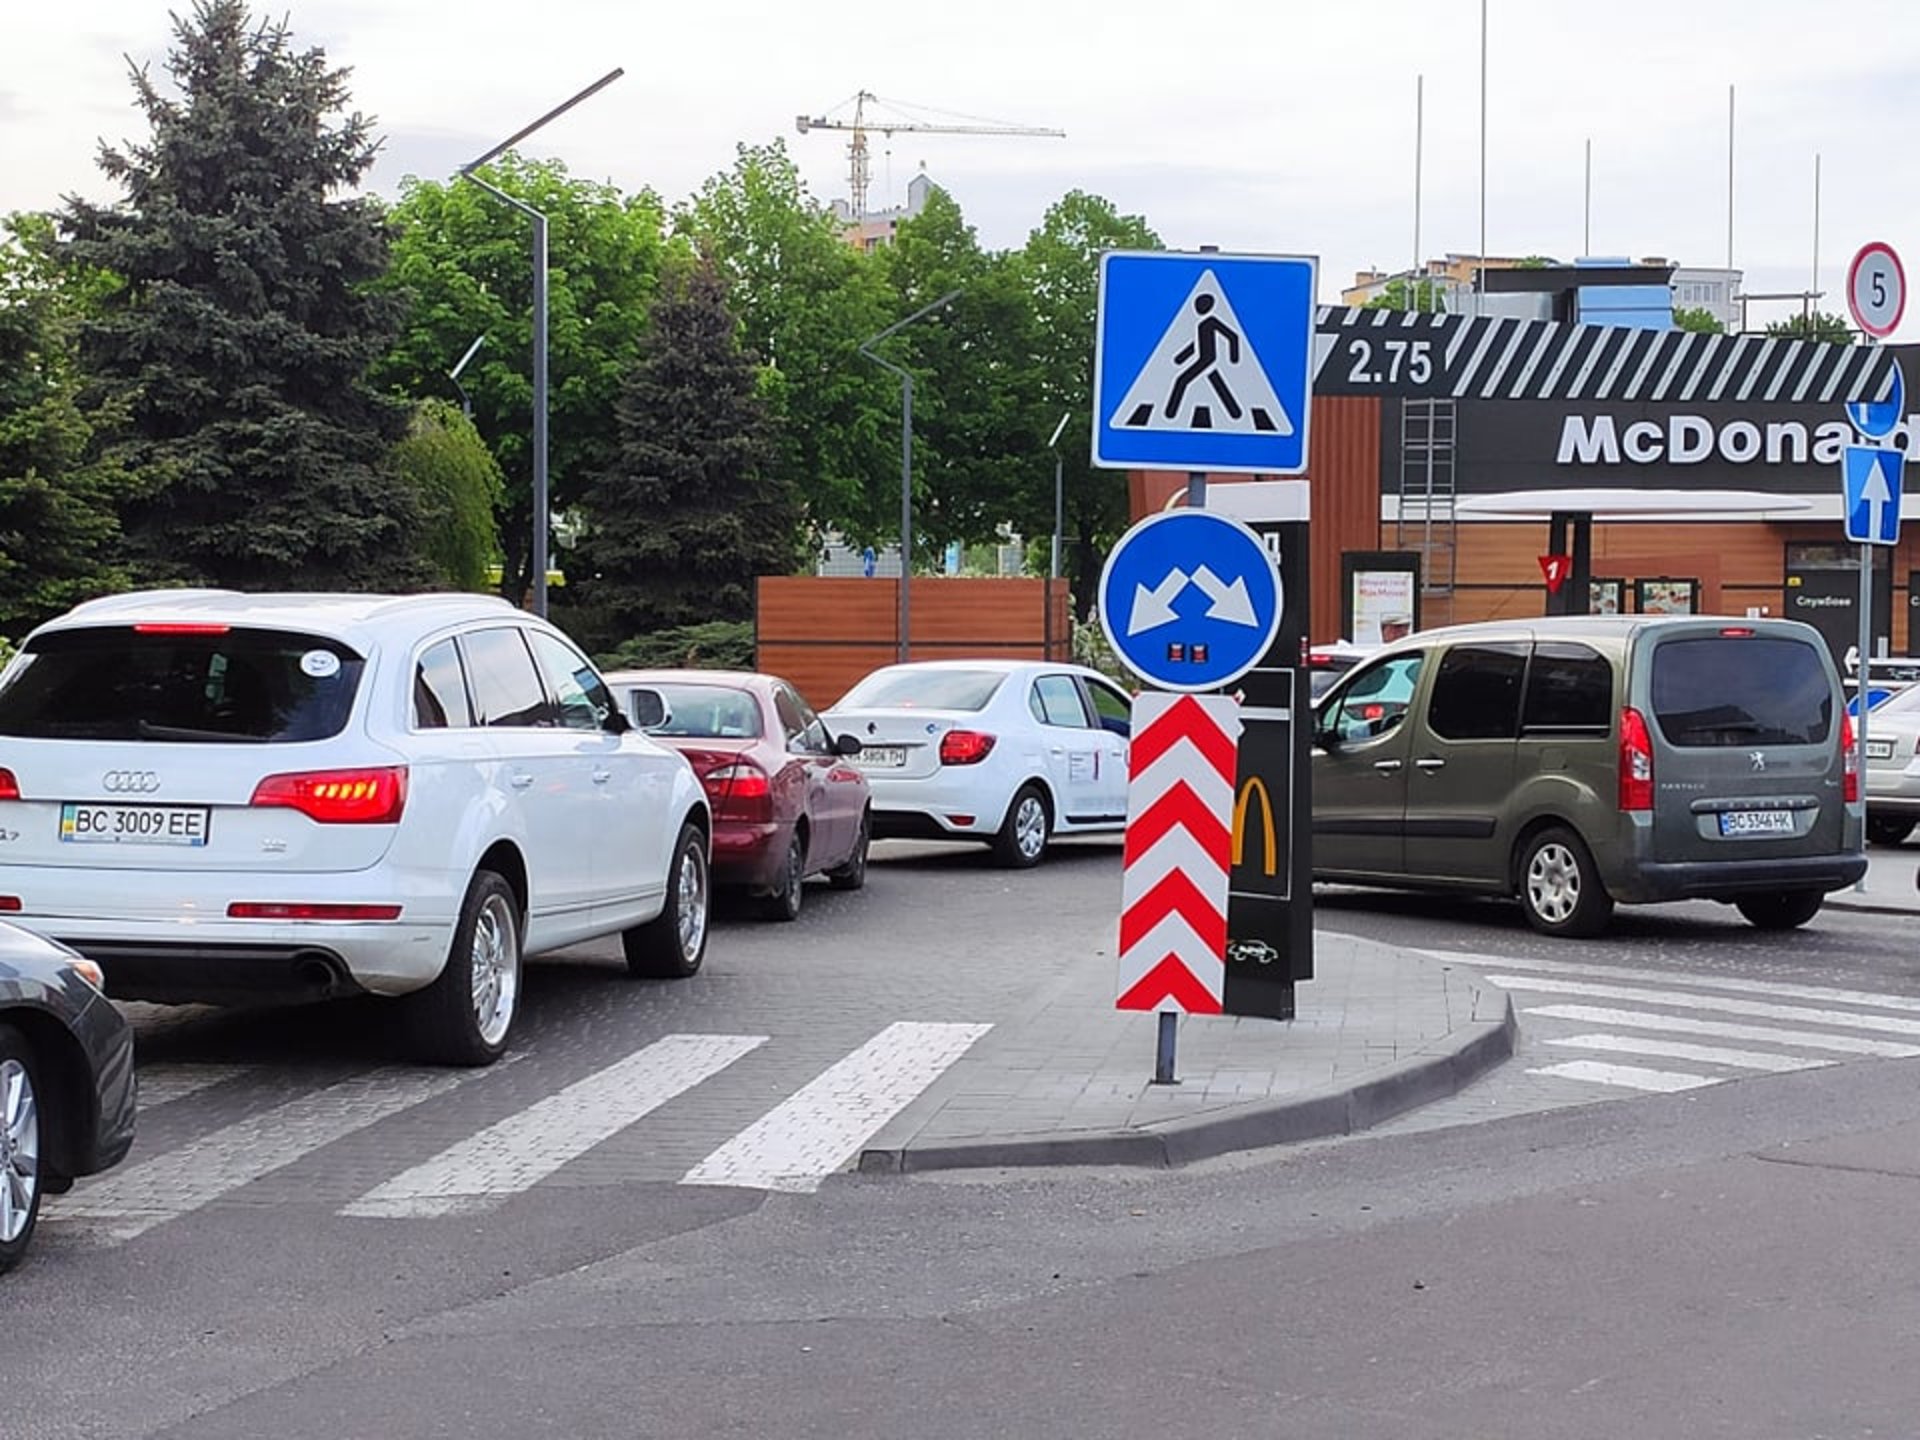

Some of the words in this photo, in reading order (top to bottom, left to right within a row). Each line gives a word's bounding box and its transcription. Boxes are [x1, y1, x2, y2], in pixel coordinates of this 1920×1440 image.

[1871, 272, 1886, 308] 5
[1348, 339, 1432, 384] 2.75
[1557, 414, 1920, 463] McDonad
[1547, 561, 1559, 579] 1
[1796, 596, 1851, 608] Службове
[76, 810, 108, 833] BC
[114, 811, 164, 834] 3009
[169, 813, 201, 836] EE
